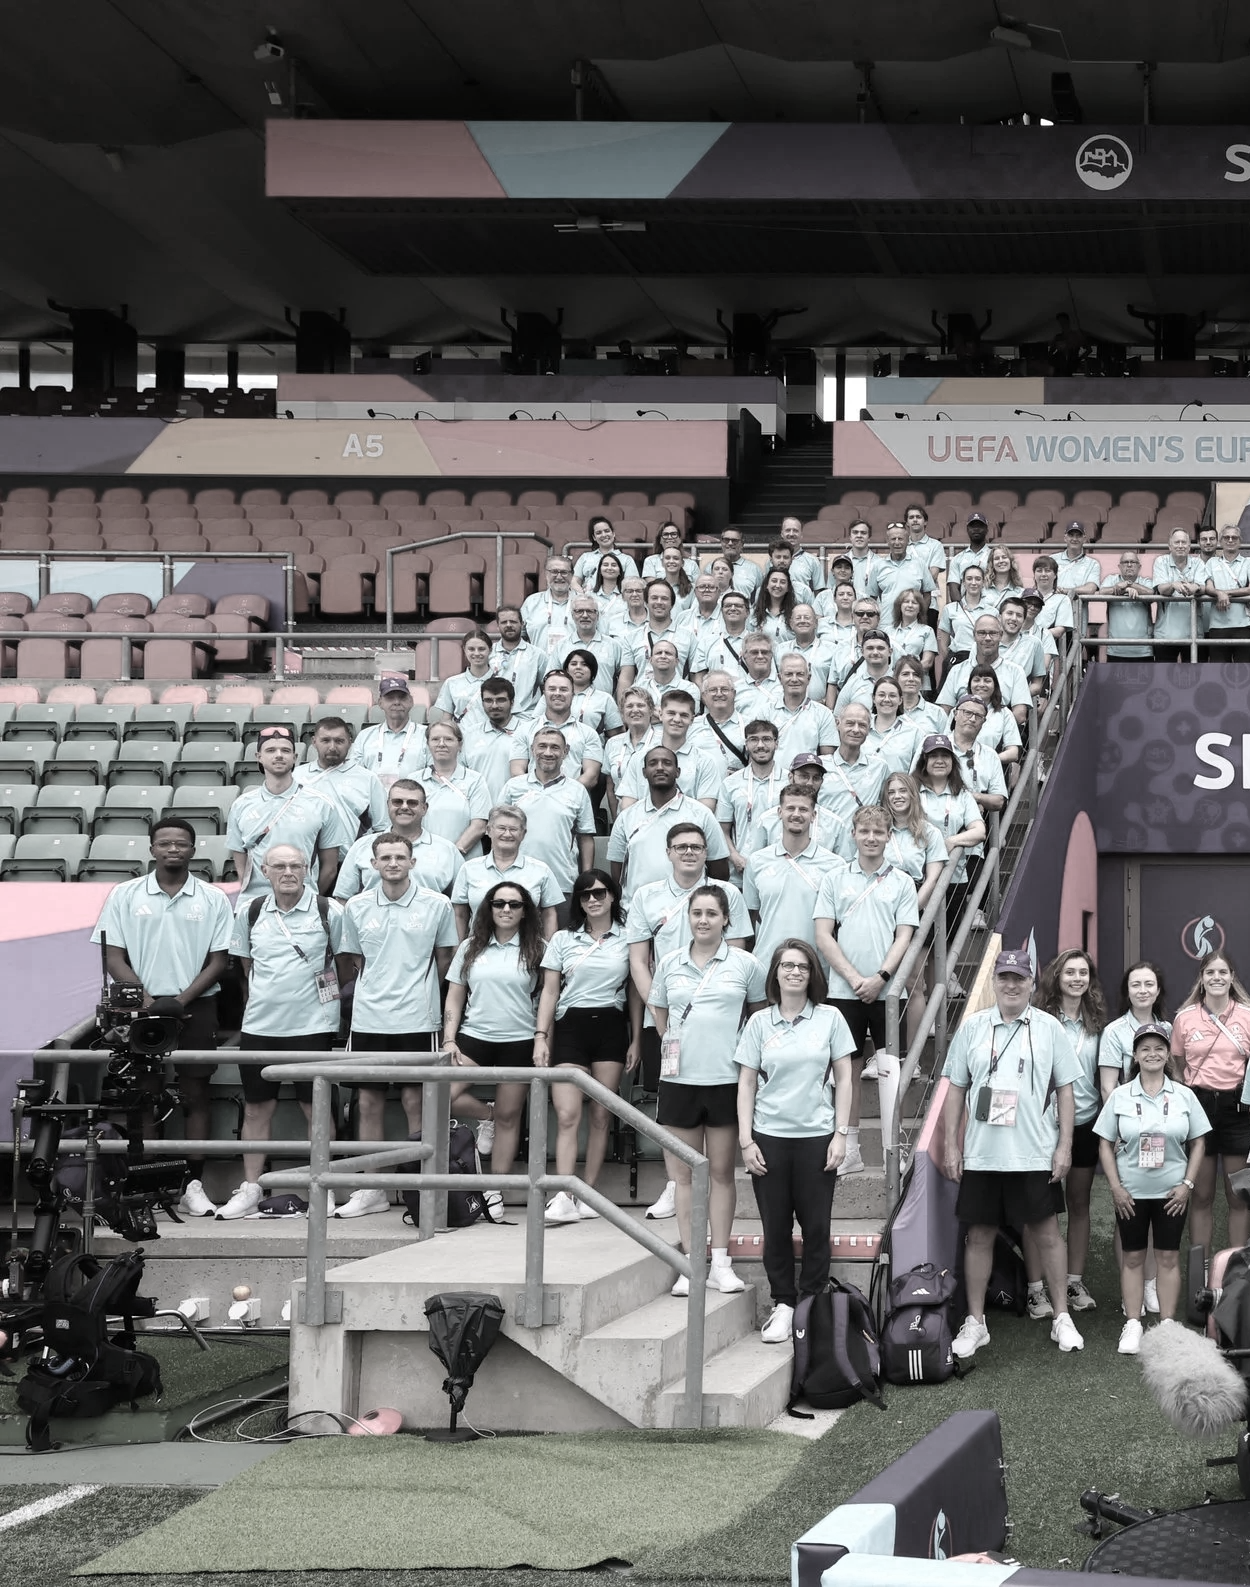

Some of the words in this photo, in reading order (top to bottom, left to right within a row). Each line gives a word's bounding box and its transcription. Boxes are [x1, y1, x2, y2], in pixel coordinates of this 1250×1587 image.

[342, 433, 384, 457] A5
[928, 435, 1018, 463] UEFA
[1025, 435, 1184, 463] WOMEN'S
